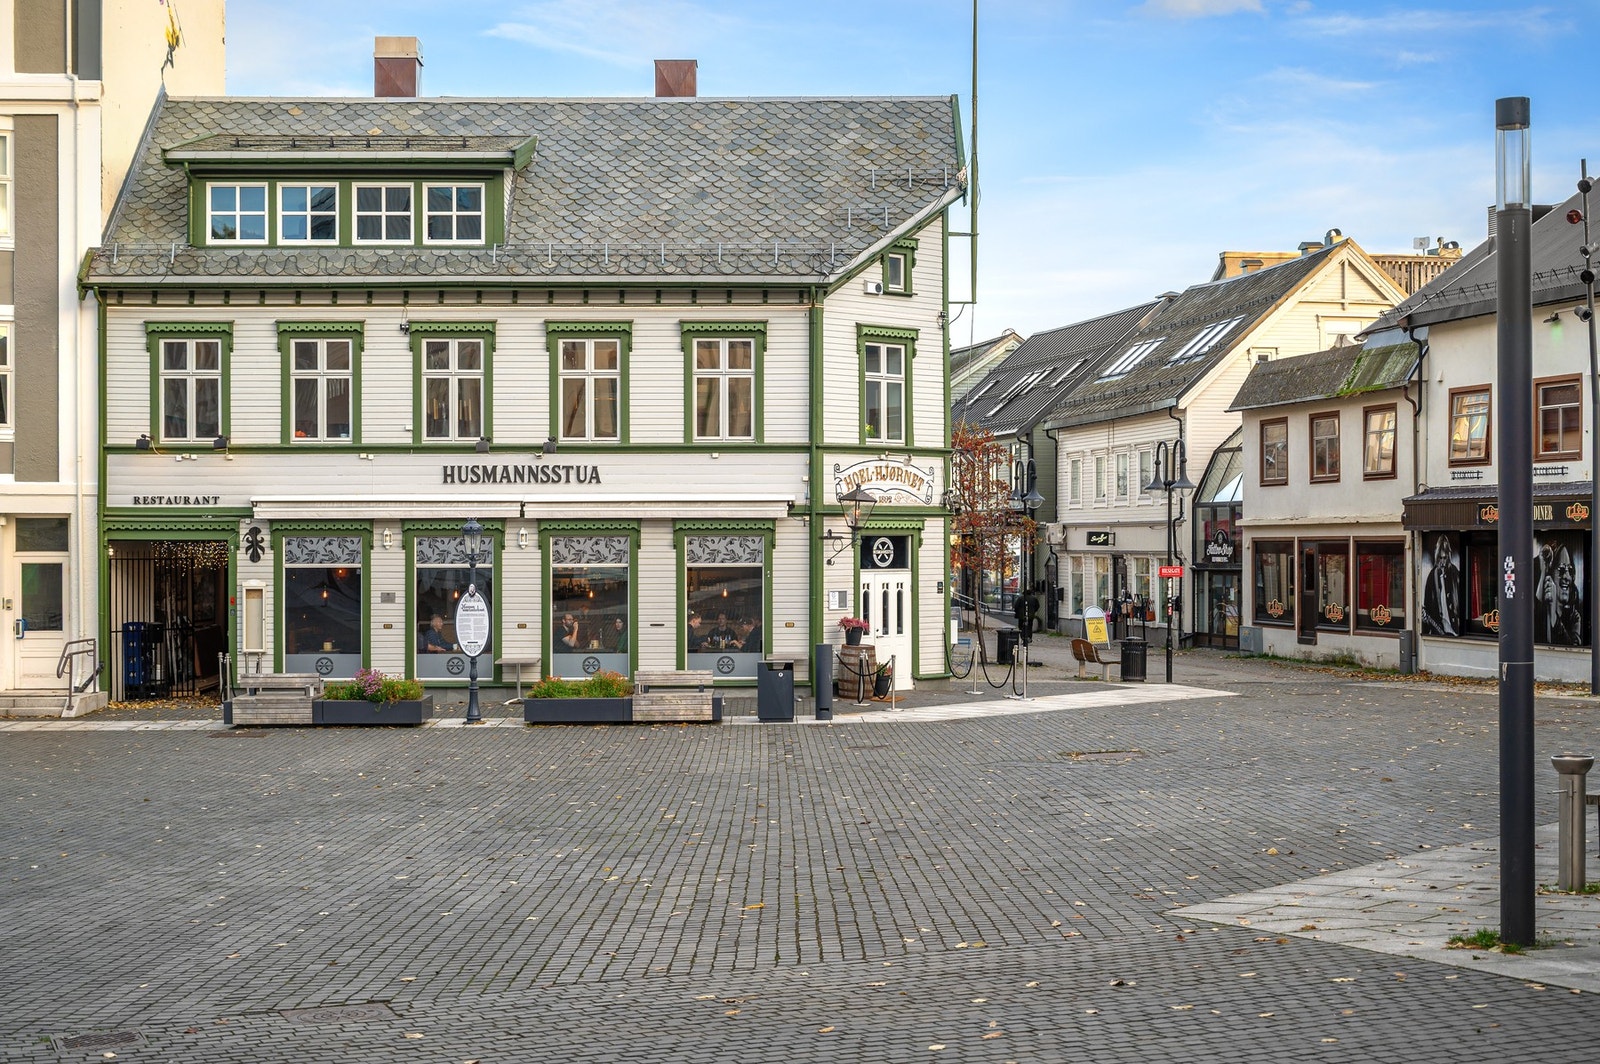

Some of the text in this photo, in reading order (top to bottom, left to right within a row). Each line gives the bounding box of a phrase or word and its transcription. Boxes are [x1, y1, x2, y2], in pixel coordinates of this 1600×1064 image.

[443, 465, 601, 484] HUSMANNSSTUA
[133, 495, 220, 505] RESTAURANT
[1533, 504, 1554, 520] DINER
